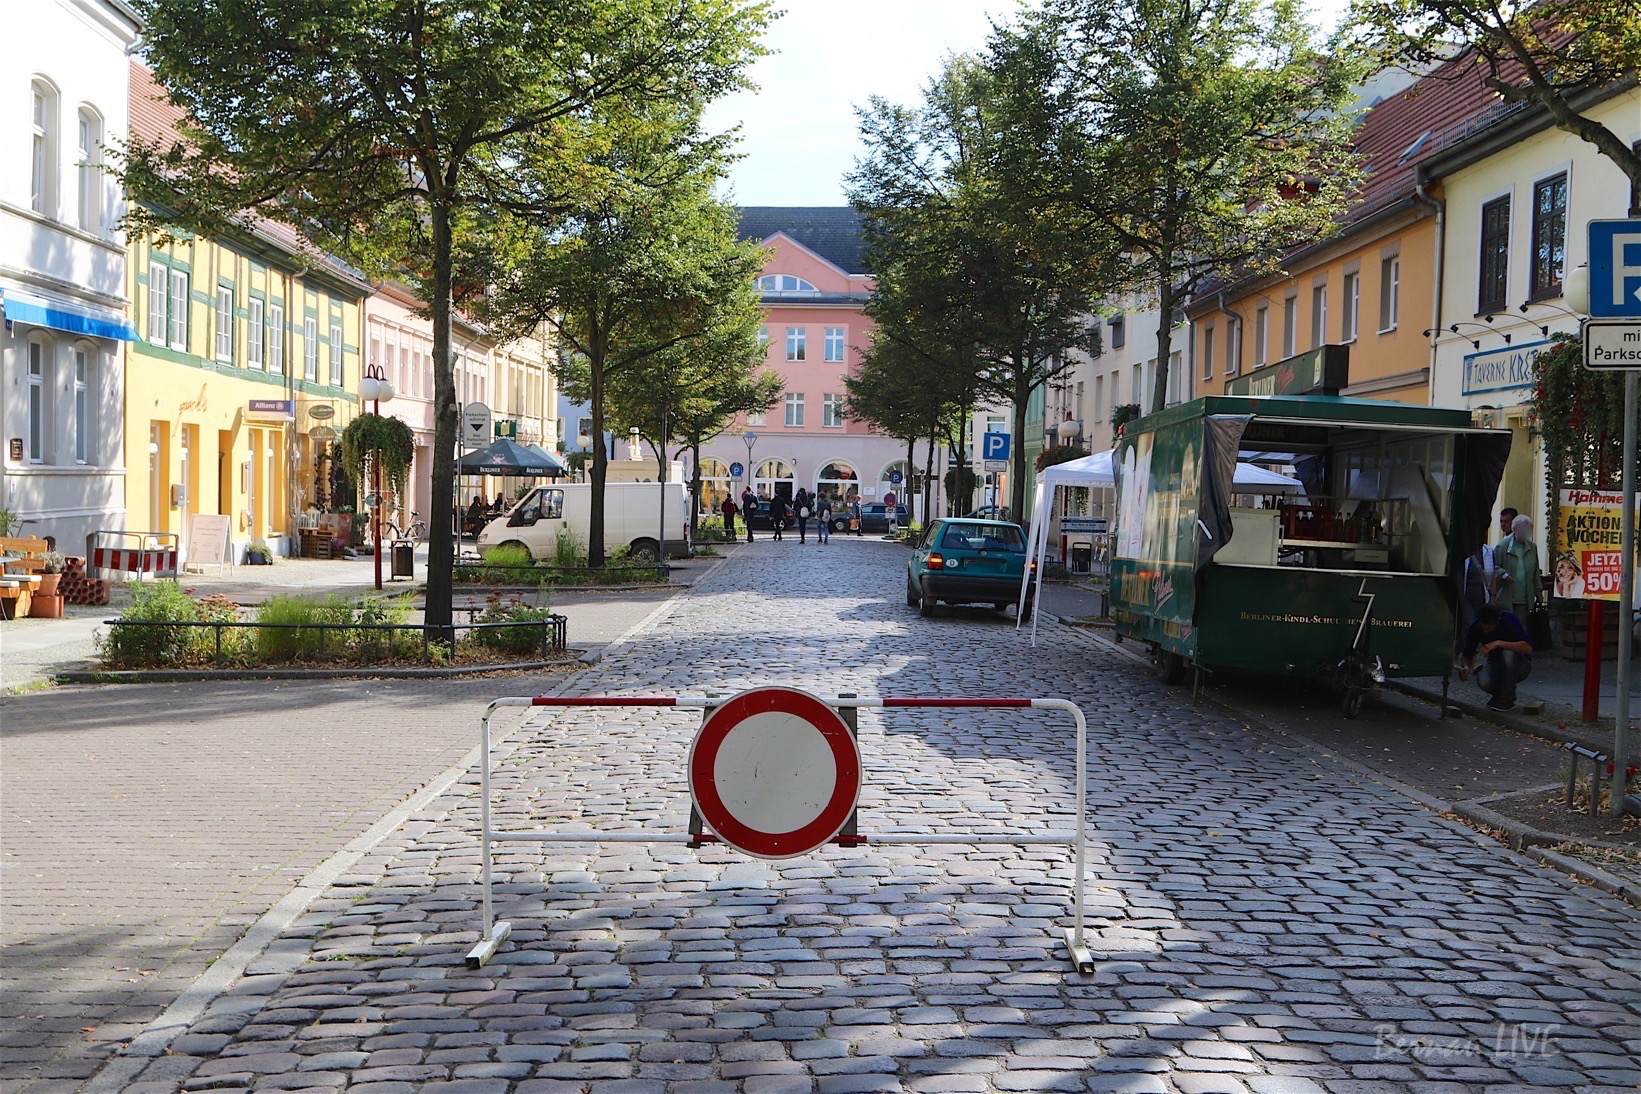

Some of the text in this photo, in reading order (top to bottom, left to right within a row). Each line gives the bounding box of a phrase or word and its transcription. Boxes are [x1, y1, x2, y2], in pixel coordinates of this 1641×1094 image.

[1623, 330, 1641, 342] mi
[1594, 346, 1641, 360] Parksc
[1474, 349, 1539, 384] TAVERNE KRET
[988, 436, 1004, 456] P
[733, 467, 739, 475] P
[1568, 490, 1623, 504] Hamme
[1566, 514, 1623, 530] AKTION
[1566, 528, 1623, 545] WOCHE
[1370, 618, 1412, 628] BRAUEREI
